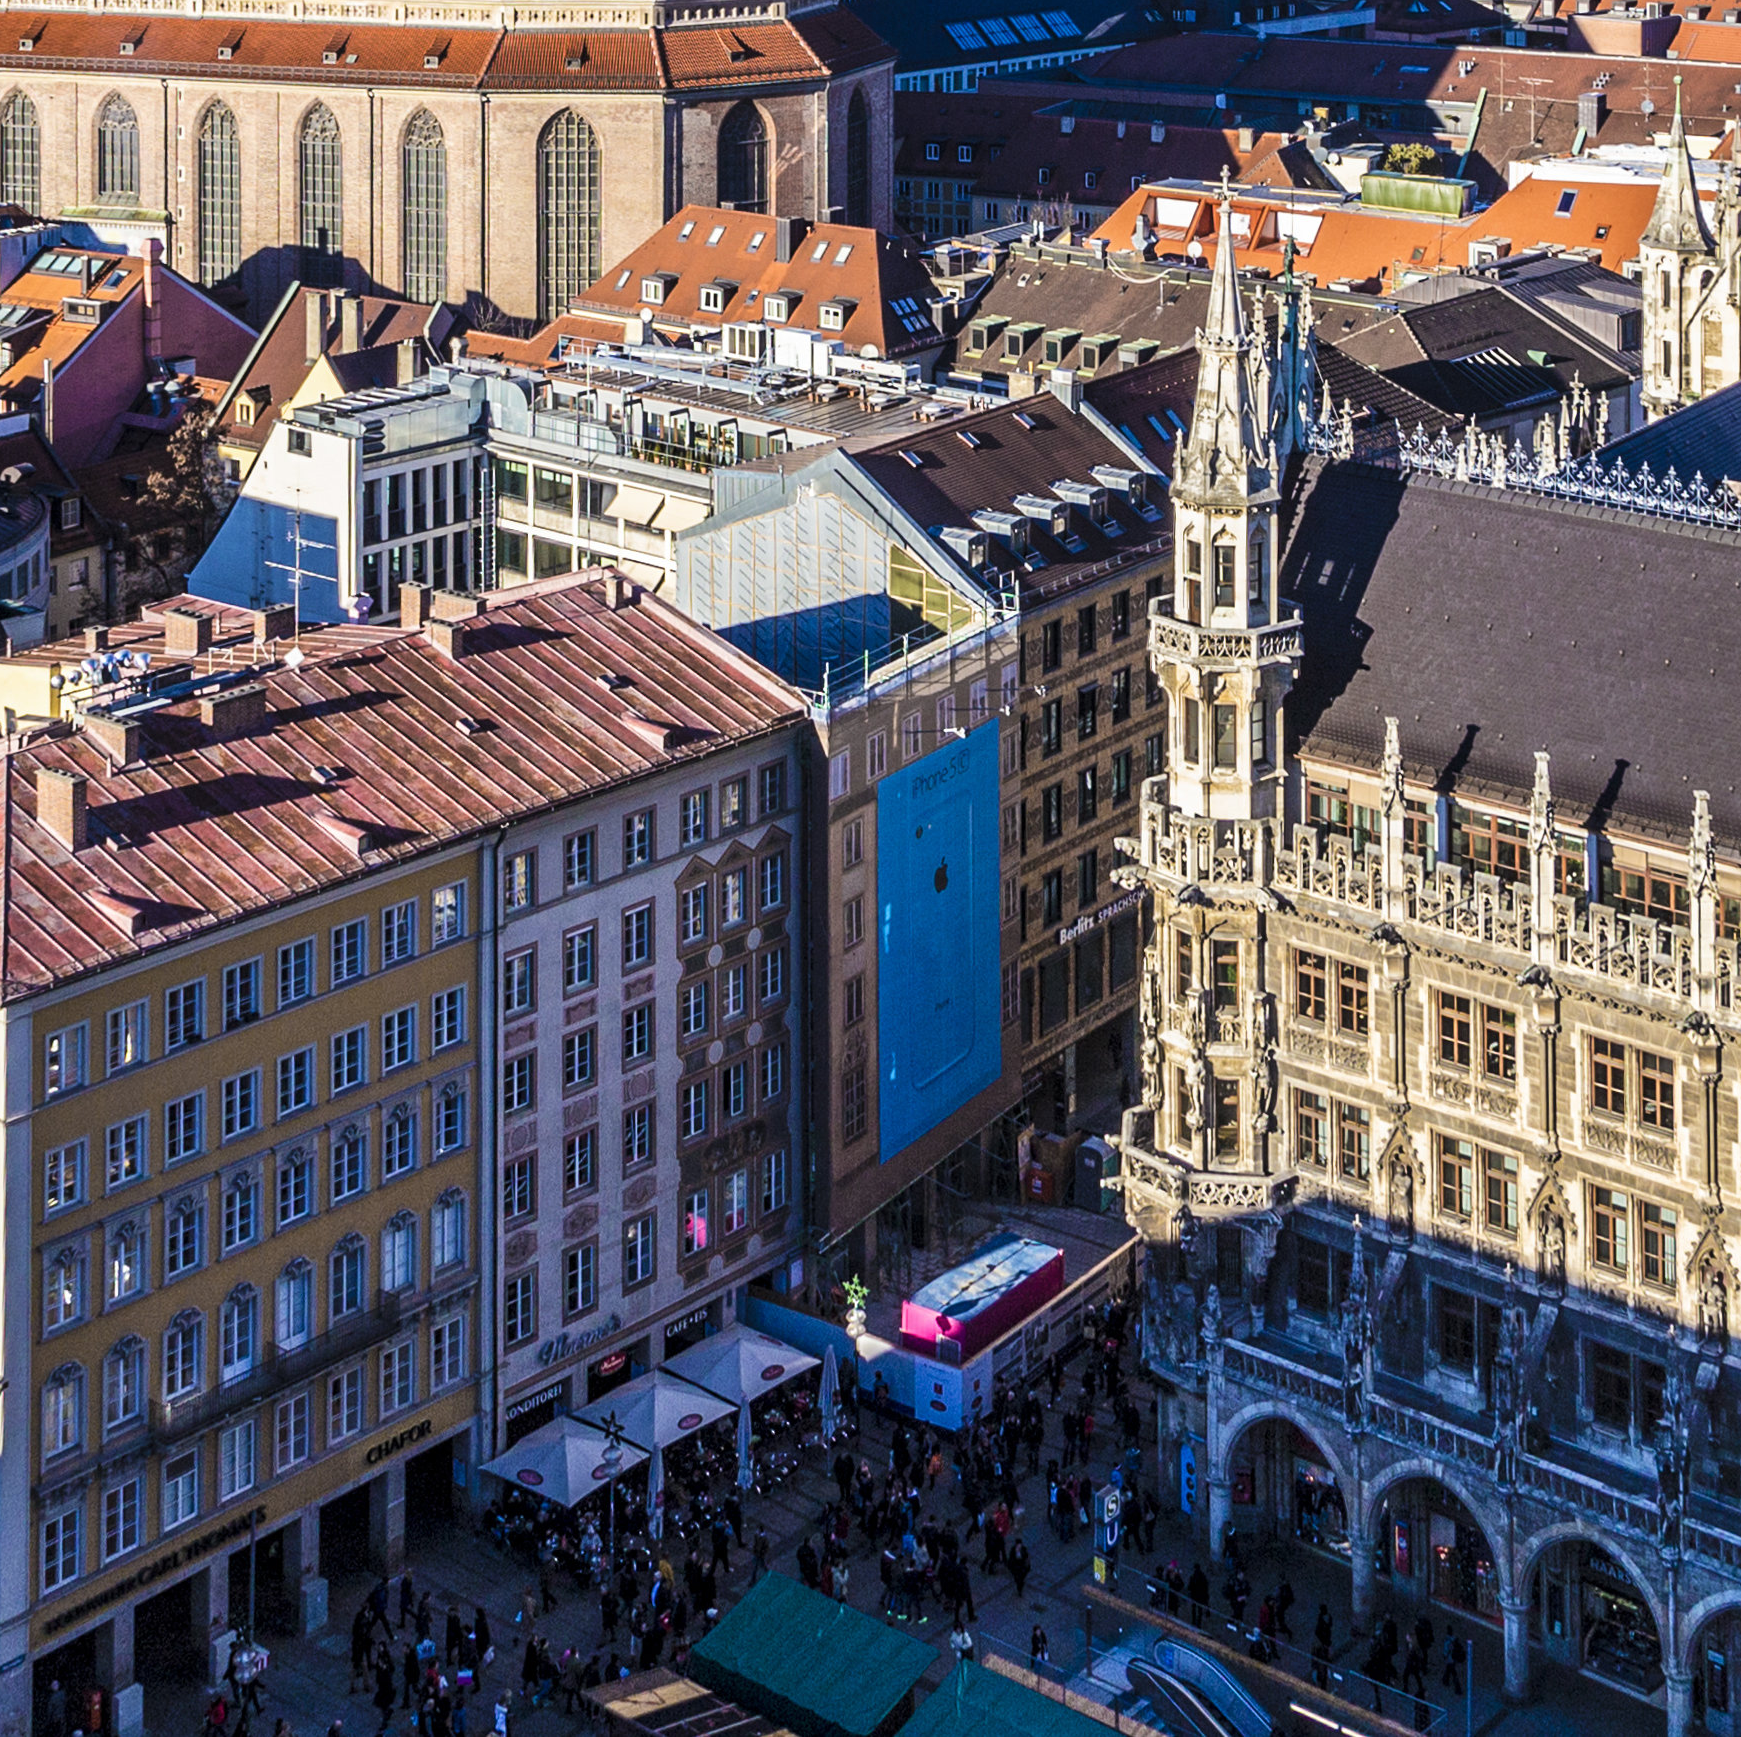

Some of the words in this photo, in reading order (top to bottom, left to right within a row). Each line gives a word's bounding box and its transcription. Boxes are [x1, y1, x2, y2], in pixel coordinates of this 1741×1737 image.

[1059, 916, 1095, 945] Berlitz
[366, 1419, 432, 1464] CHAFOR
[1106, 1520, 1119, 1546] U
